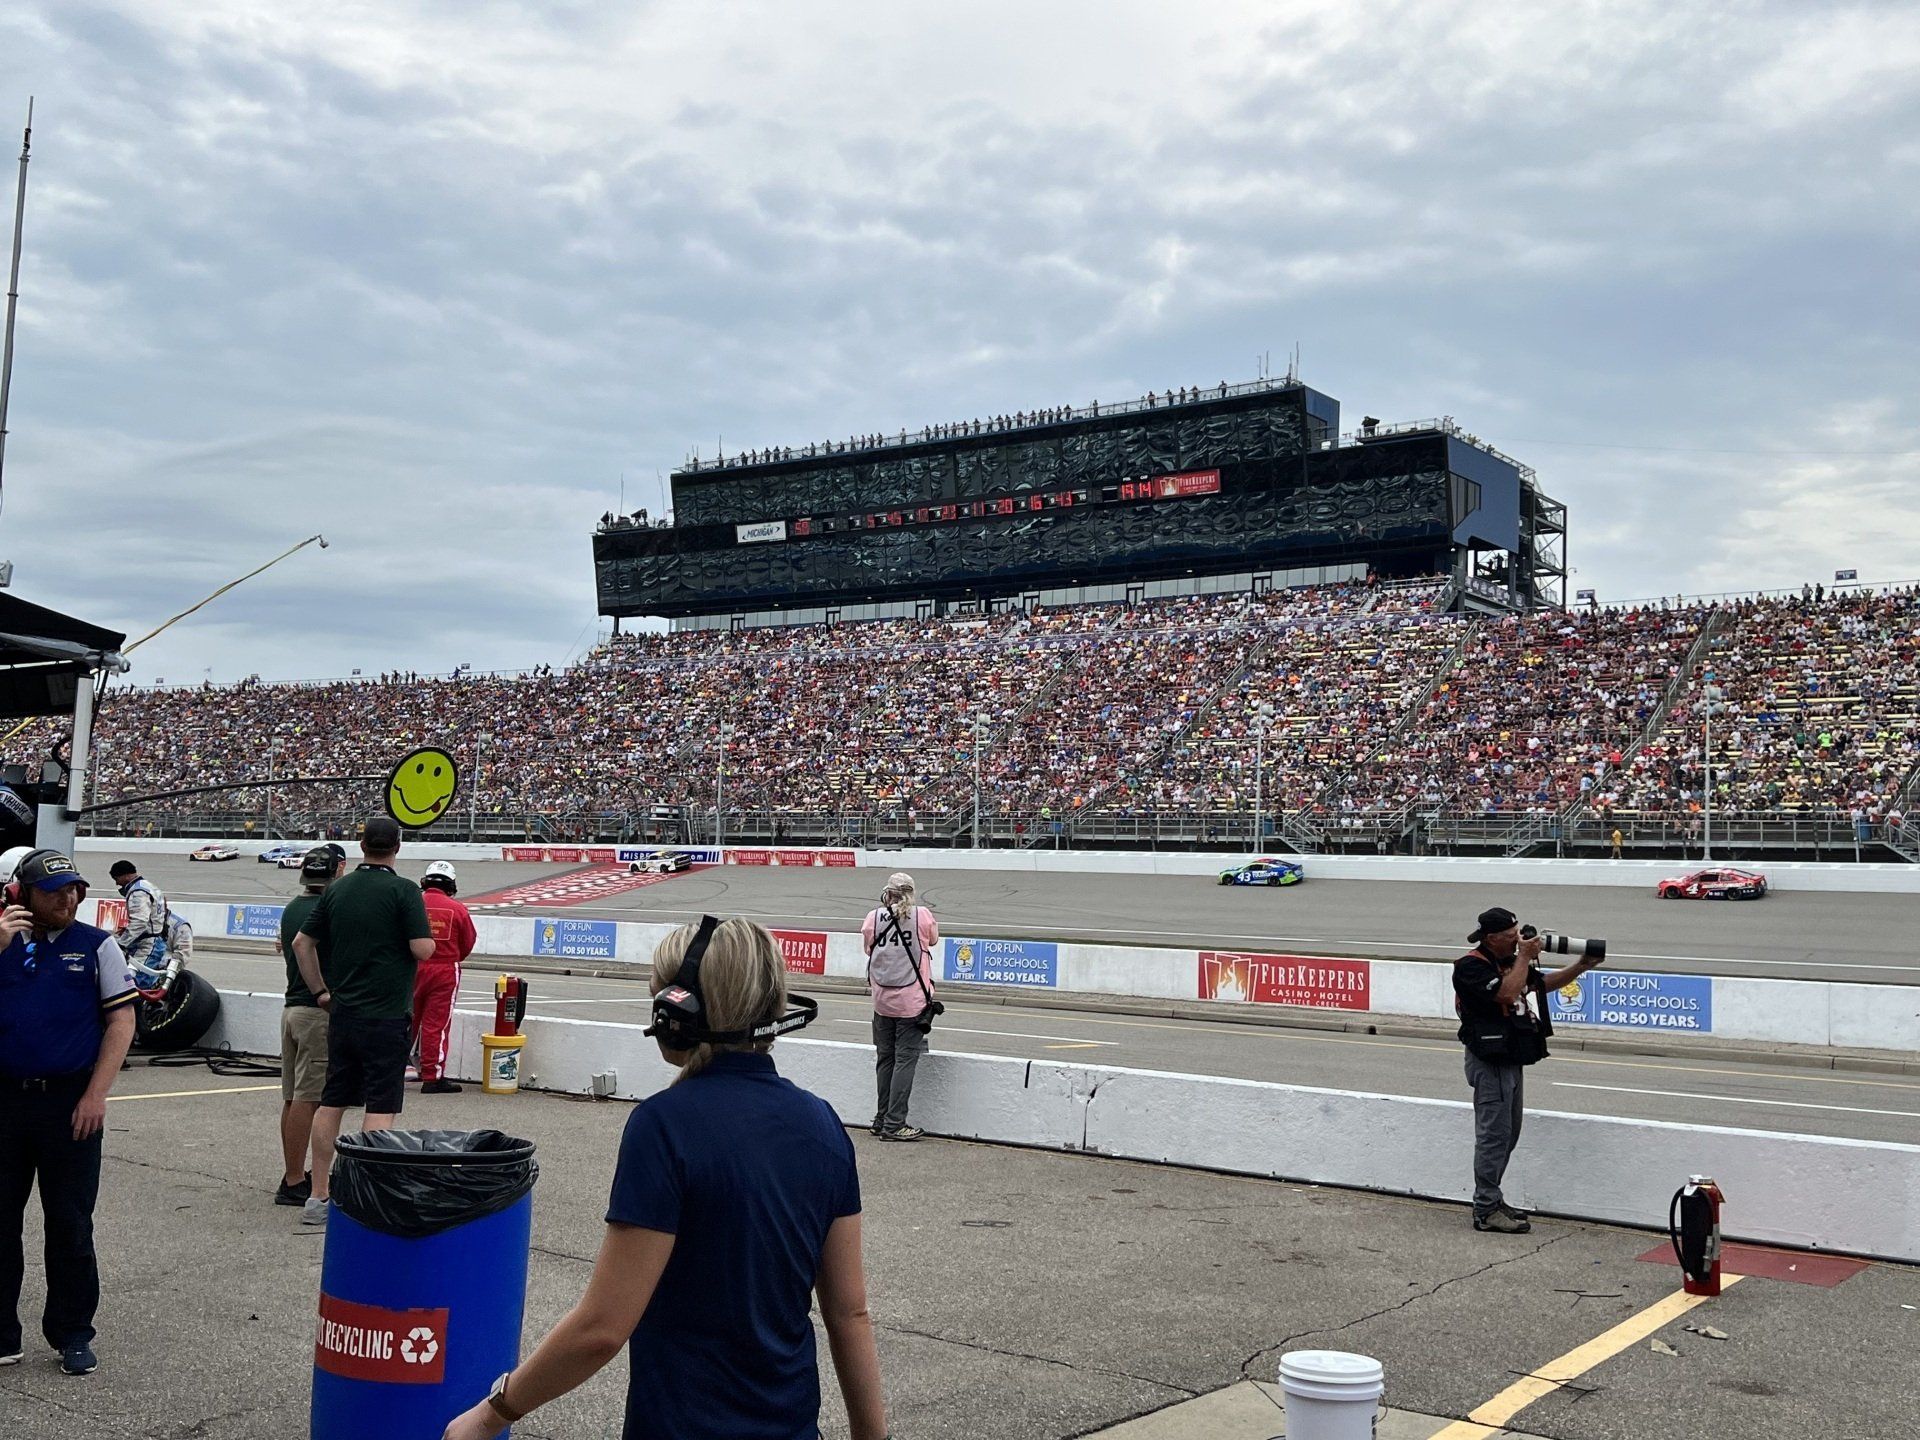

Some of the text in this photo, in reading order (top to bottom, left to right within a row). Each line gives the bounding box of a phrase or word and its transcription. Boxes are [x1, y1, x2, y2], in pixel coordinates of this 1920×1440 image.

[747, 527, 774, 538] MICHIGAN
[1686, 883, 1698, 895] 4
[564, 922, 577, 931] FOR
[563, 933, 610, 944] FOR SCHOOLS.
[562, 946, 610, 956] FOR 50 YEARS.
[985, 942, 1024, 954] FOR FUN.
[792, 960, 814, 968] HOTEL
[984, 956, 1050, 970] FOR SCHOOLS.
[952, 972, 976, 980] LOTTERY
[984, 970, 1049, 984] FOR 50 YEARS.
[1600, 976, 1661, 991] FOR FUN.
[1270, 988, 1353, 1002] CASINO HOTEL
[1316, 1000, 1340, 1008] CREEK
[1600, 994, 1700, 1011] FOR SCHOOLS.
[1552, 1012, 1587, 1022] LOTTERY
[1600, 1011, 1700, 1028] FOR 50 YEARS.
[325, 1320, 394, 1360] RECYCLING
